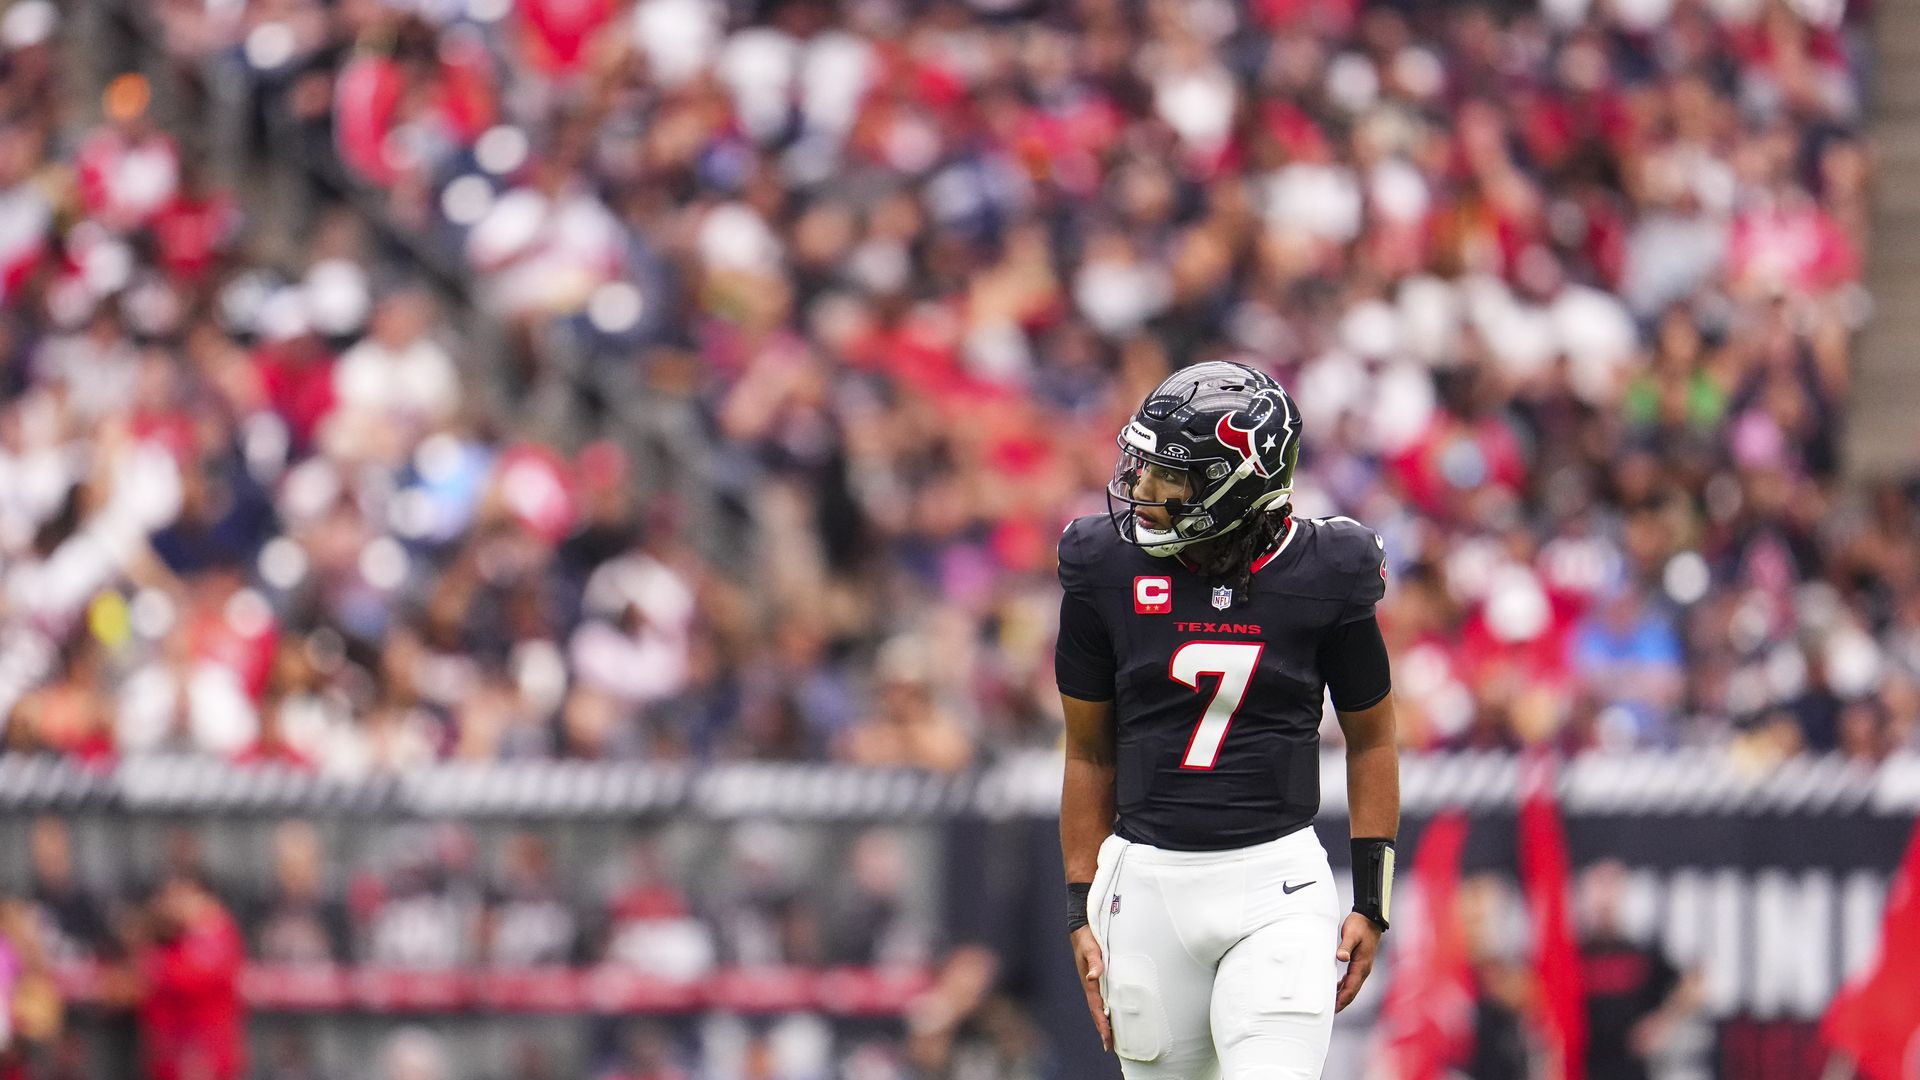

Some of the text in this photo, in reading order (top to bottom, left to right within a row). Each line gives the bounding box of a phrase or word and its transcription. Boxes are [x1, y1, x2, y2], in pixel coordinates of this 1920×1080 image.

[1163, 450, 1188, 459] OAKLEY
[1136, 578, 1169, 604] C
[1173, 621, 1262, 634] TEXANS
[1168, 639, 1266, 771] 7
